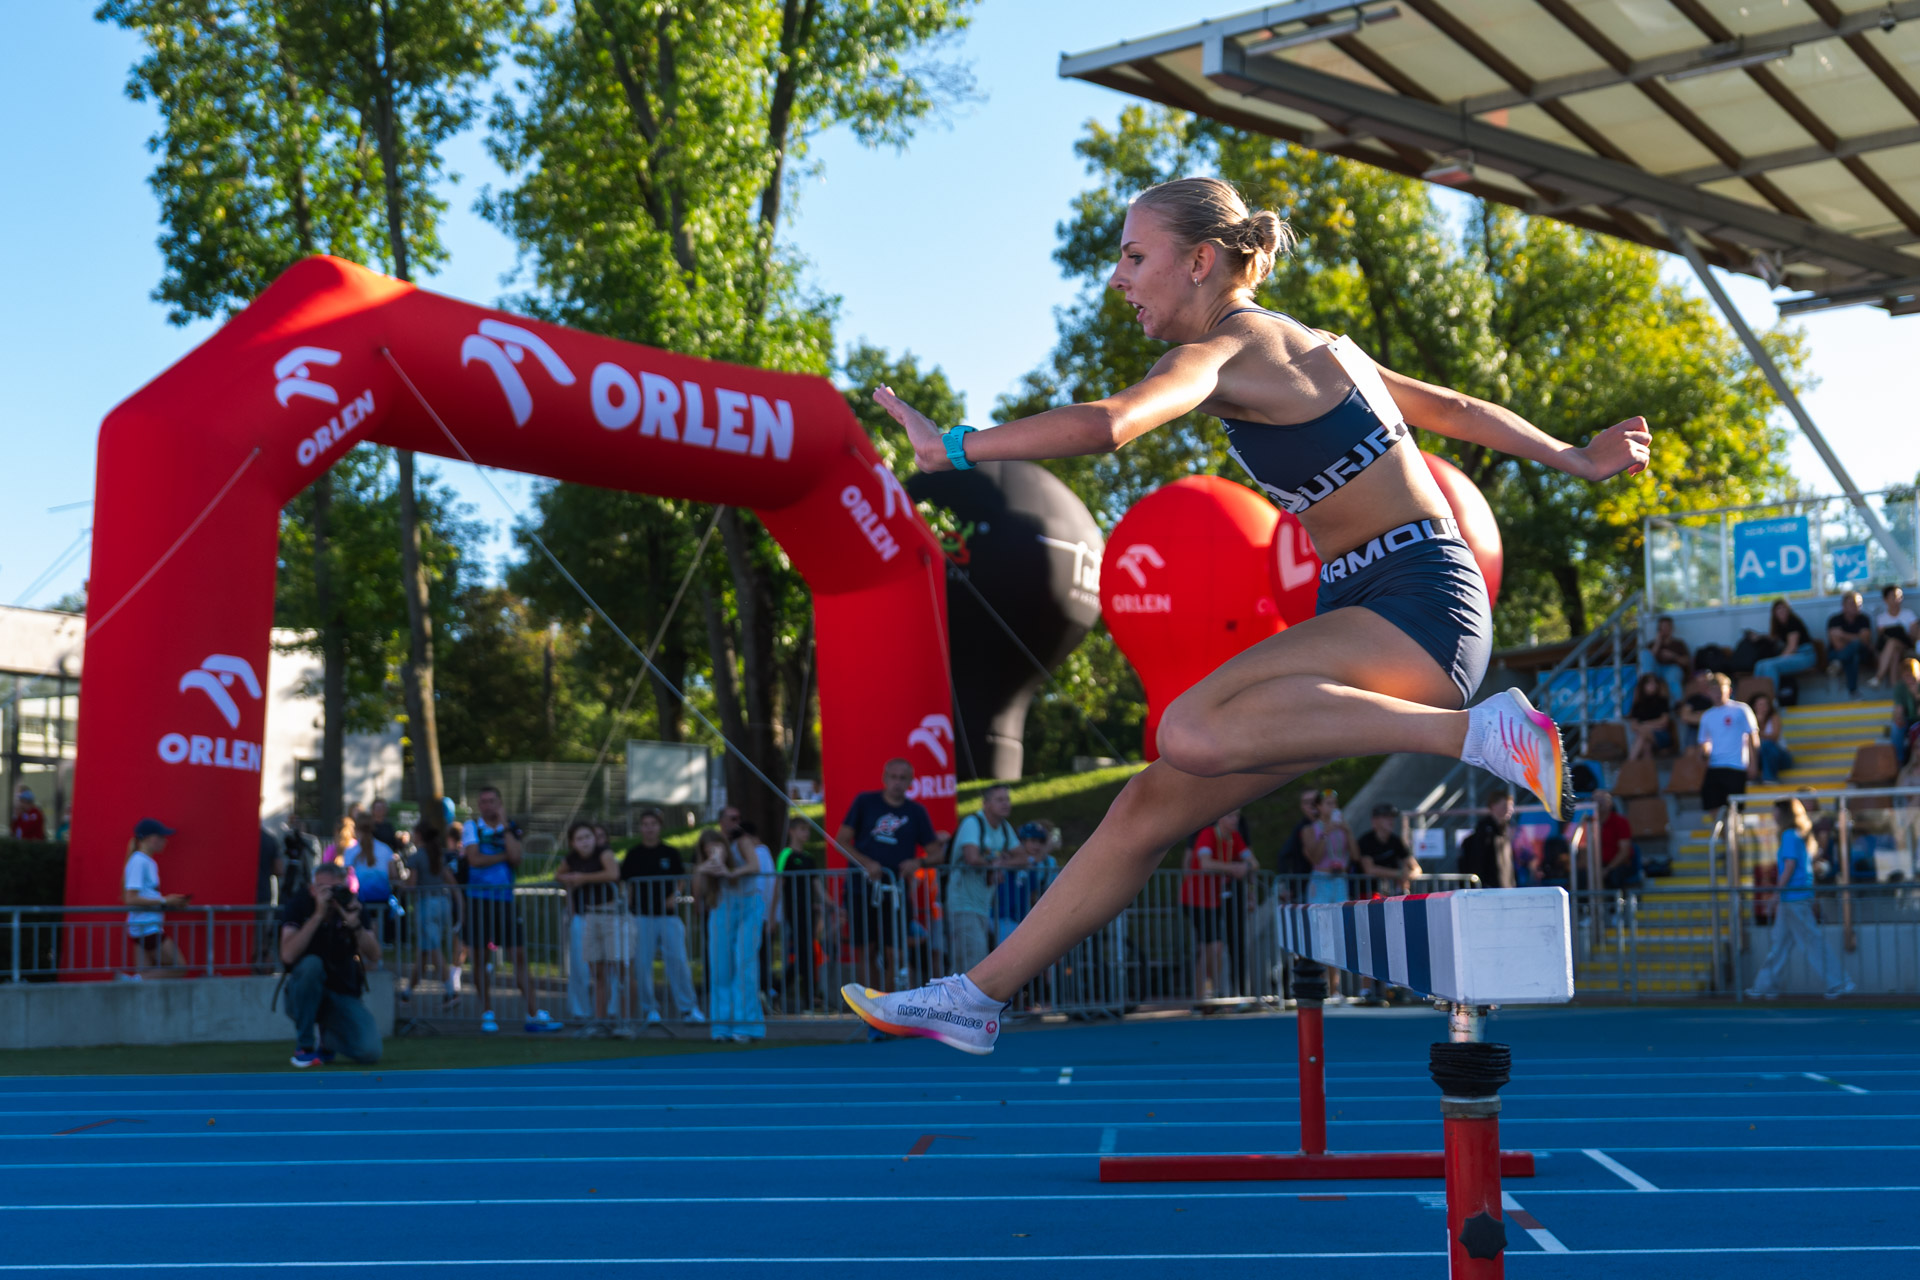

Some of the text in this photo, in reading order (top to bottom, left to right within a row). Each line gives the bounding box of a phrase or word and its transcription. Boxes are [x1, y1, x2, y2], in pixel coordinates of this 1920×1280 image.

[297, 388, 375, 467] ORLEN
[590, 361, 794, 462] ORLEN
[840, 484, 901, 562] ORLEN
[1737, 544, 1807, 579] A-D
[1111, 593, 1172, 614] ORLEN
[157, 732, 262, 773] ORLEN
[897, 1004, 984, 1030] new balance
